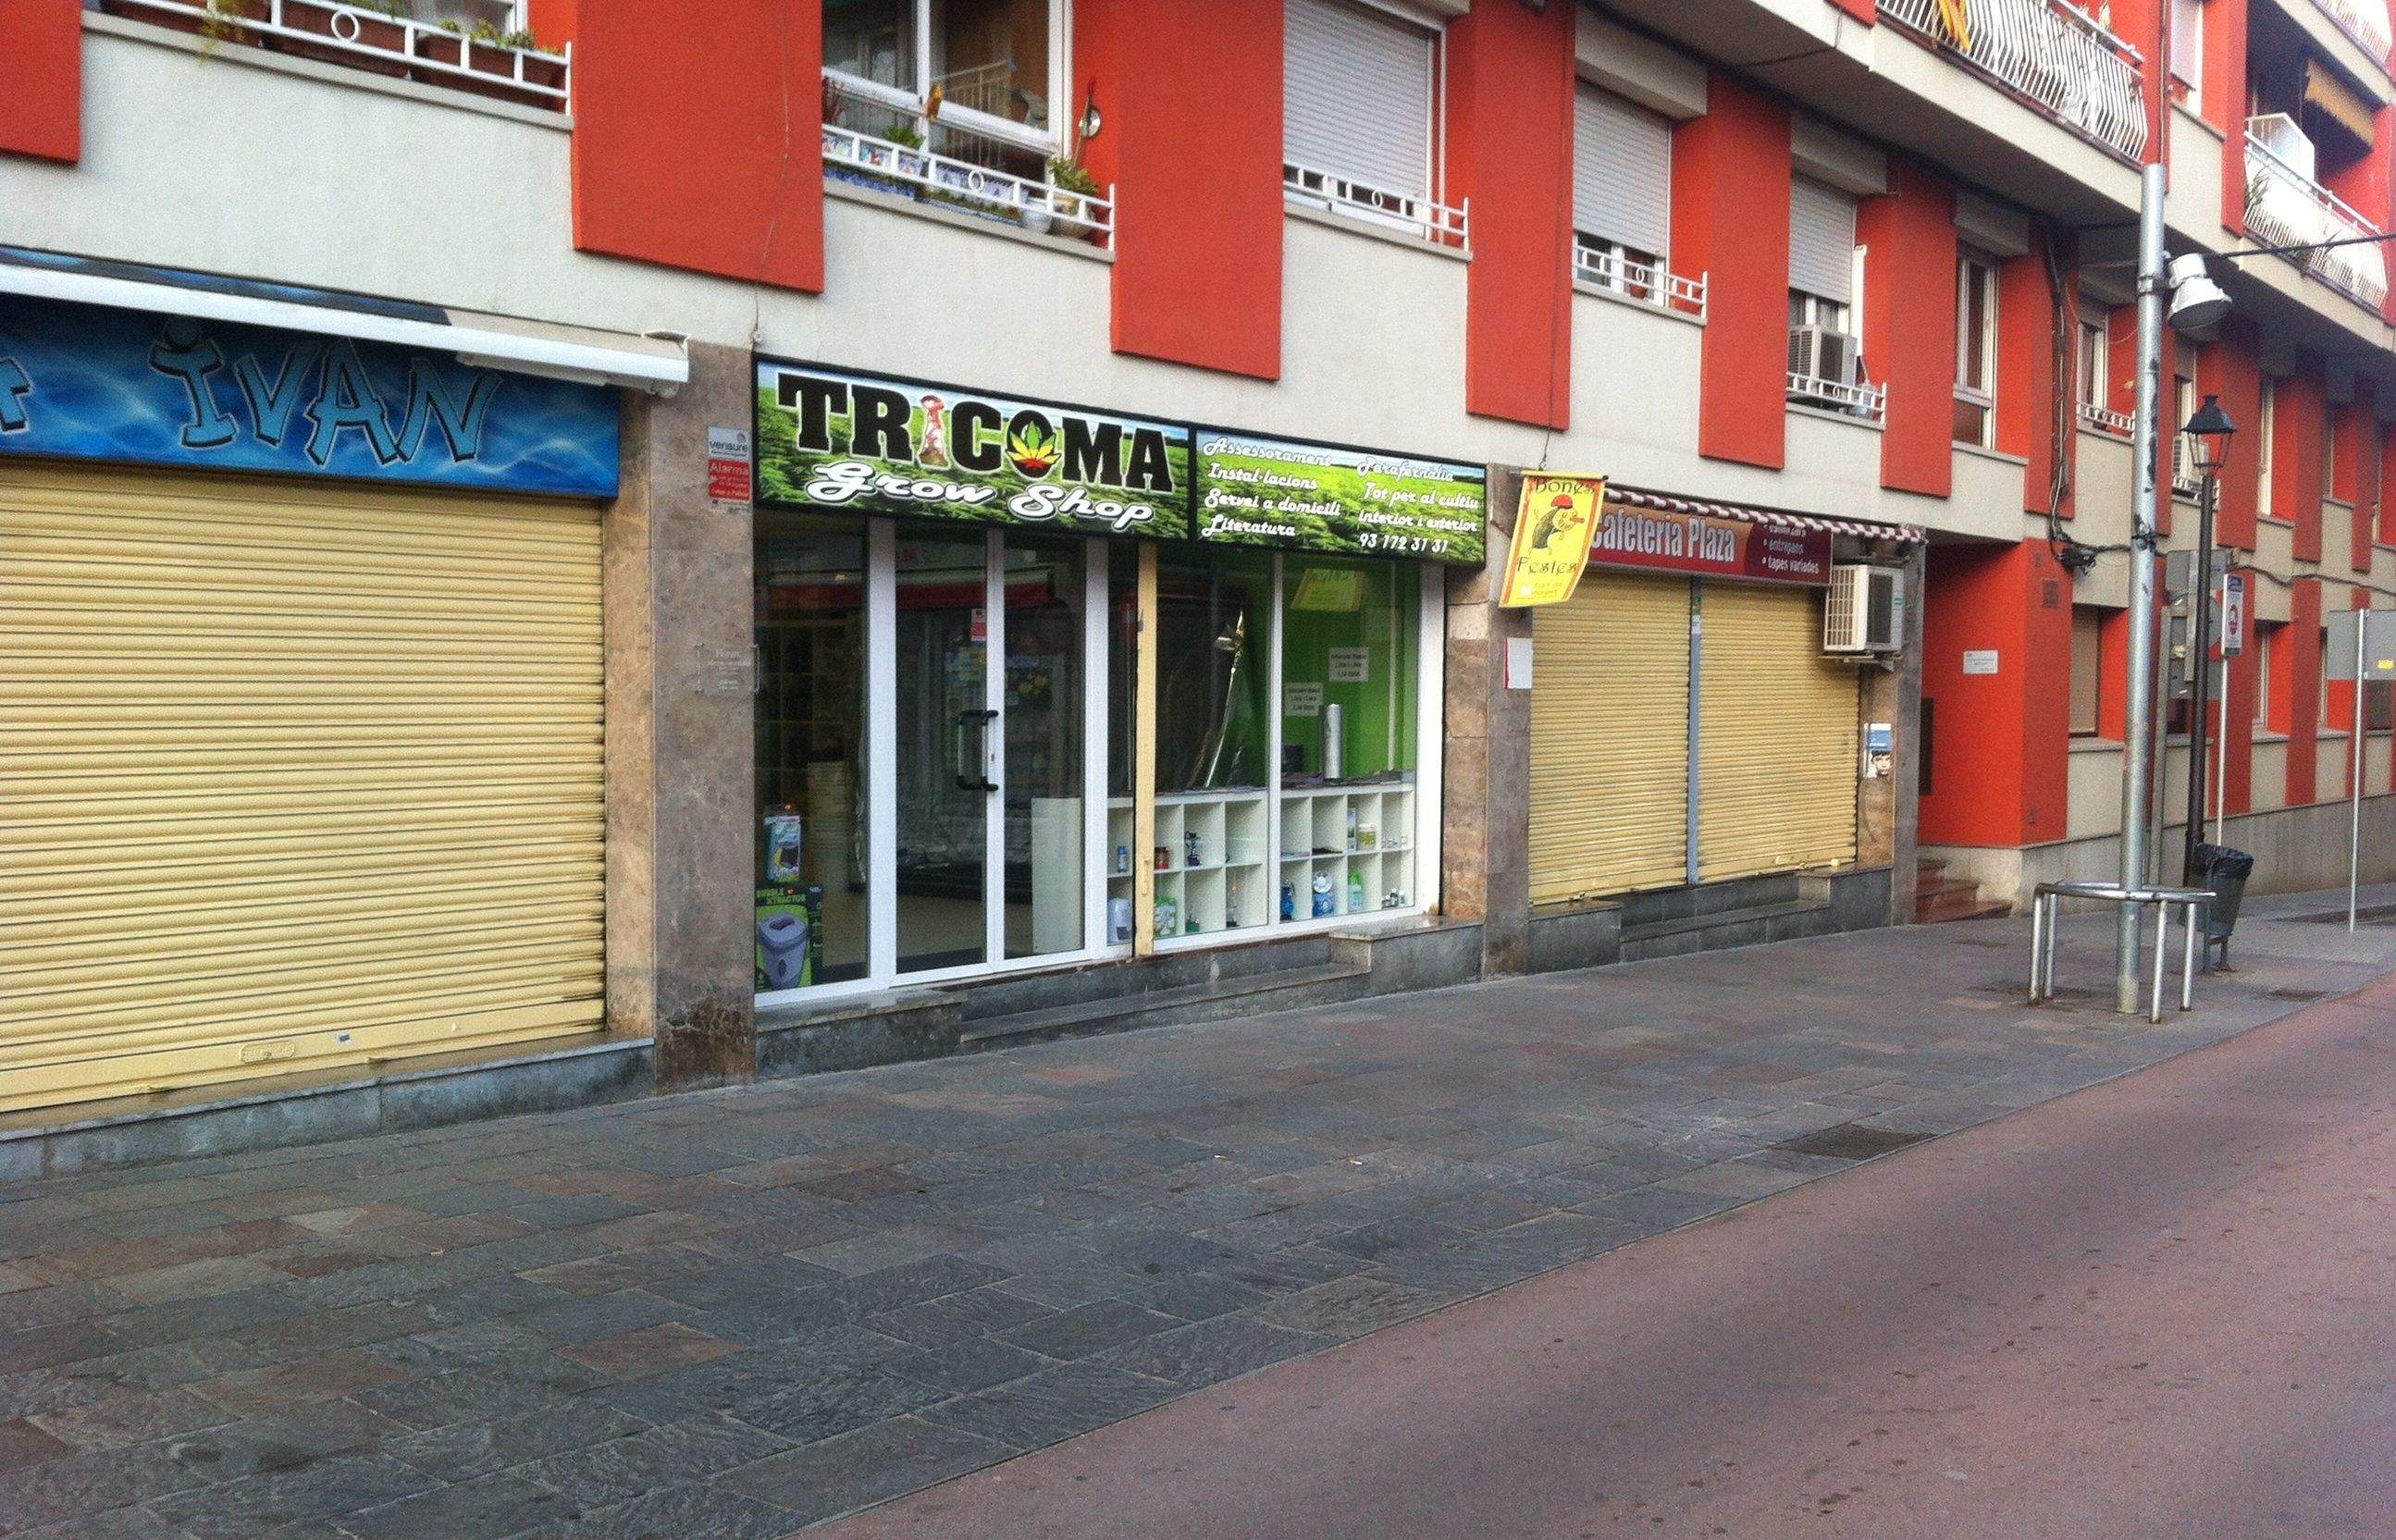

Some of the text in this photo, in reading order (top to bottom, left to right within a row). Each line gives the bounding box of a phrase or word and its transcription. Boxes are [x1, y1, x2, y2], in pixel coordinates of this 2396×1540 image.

[777, 372, 1174, 493] TRICOMA
[1203, 437, 1331, 466] Assessorament
[805, 461, 1155, 533] Grow Shop
[1204, 487, 1341, 516] Servei a domicili
[1364, 482, 1478, 510] Tot per al cultiu
[1202, 513, 1295, 537] Literatura
[1426, 518, 1477, 532] exterior
[1360, 533, 1448, 553] 93 172 31 31
[1687, 517, 1735, 562] Plaza
[1517, 556, 1577, 574] Festes
